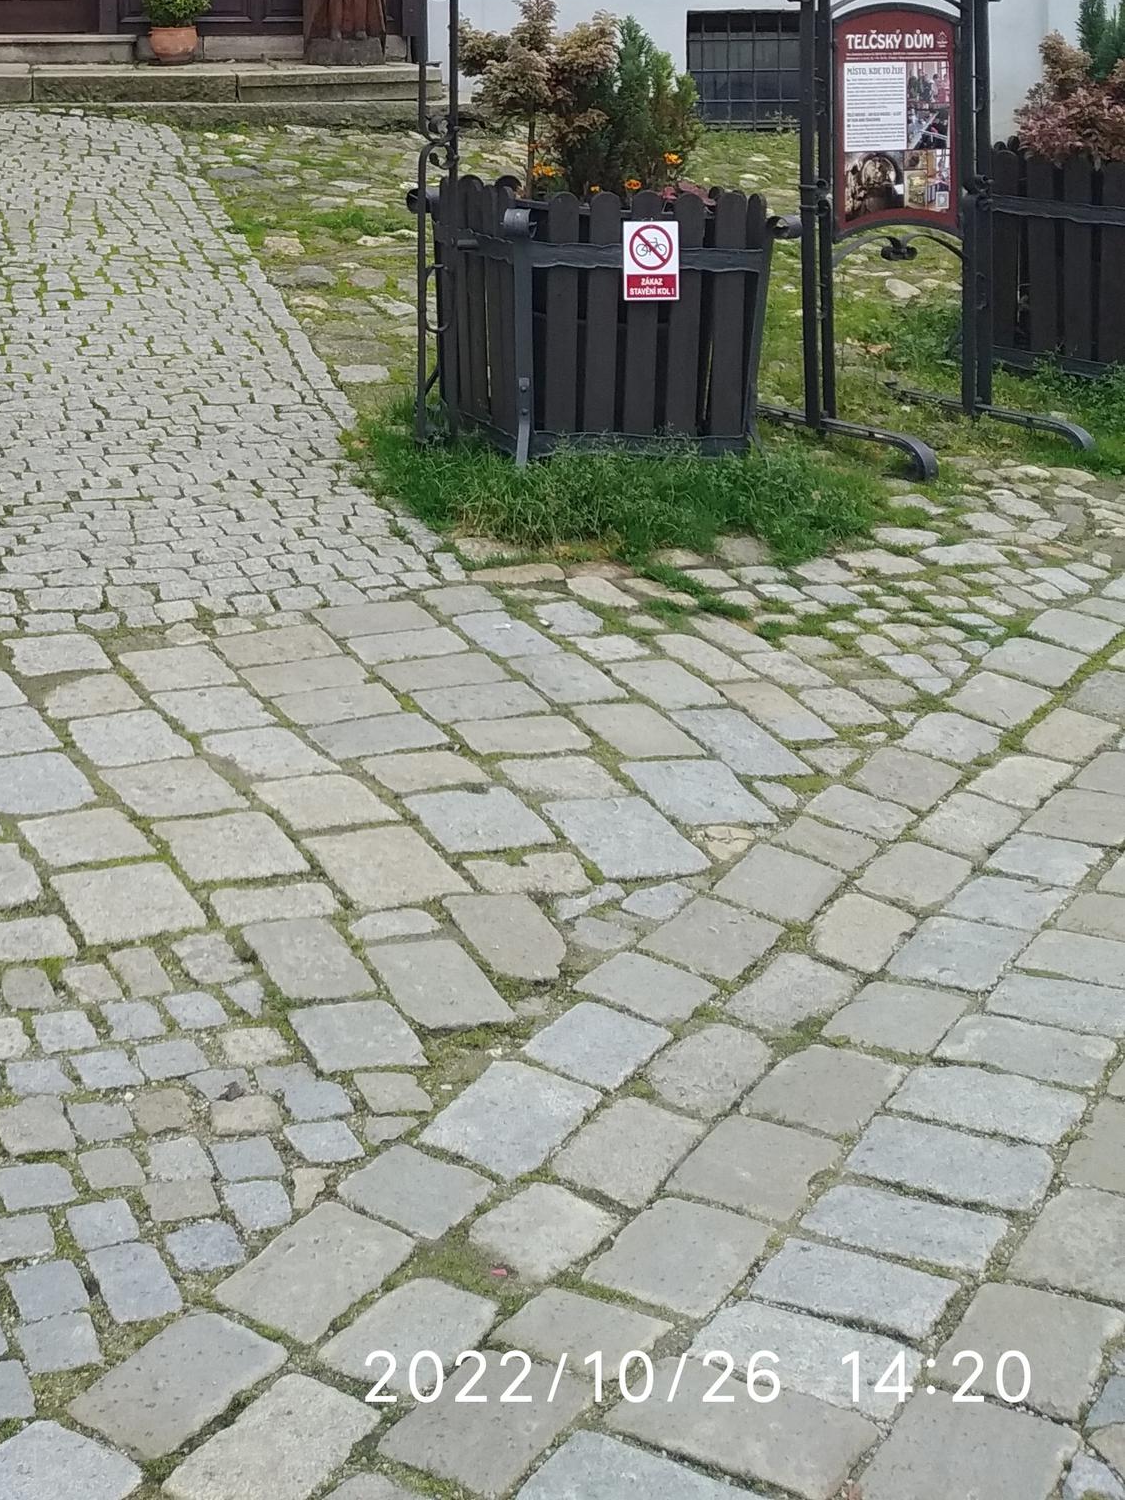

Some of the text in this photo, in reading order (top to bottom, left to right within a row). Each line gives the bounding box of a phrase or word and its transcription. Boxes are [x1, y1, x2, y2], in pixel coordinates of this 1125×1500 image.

[845, 29, 934, 50] TELČSKÝ DŮM
[641, 276, 663, 286] ZÁKAZ
